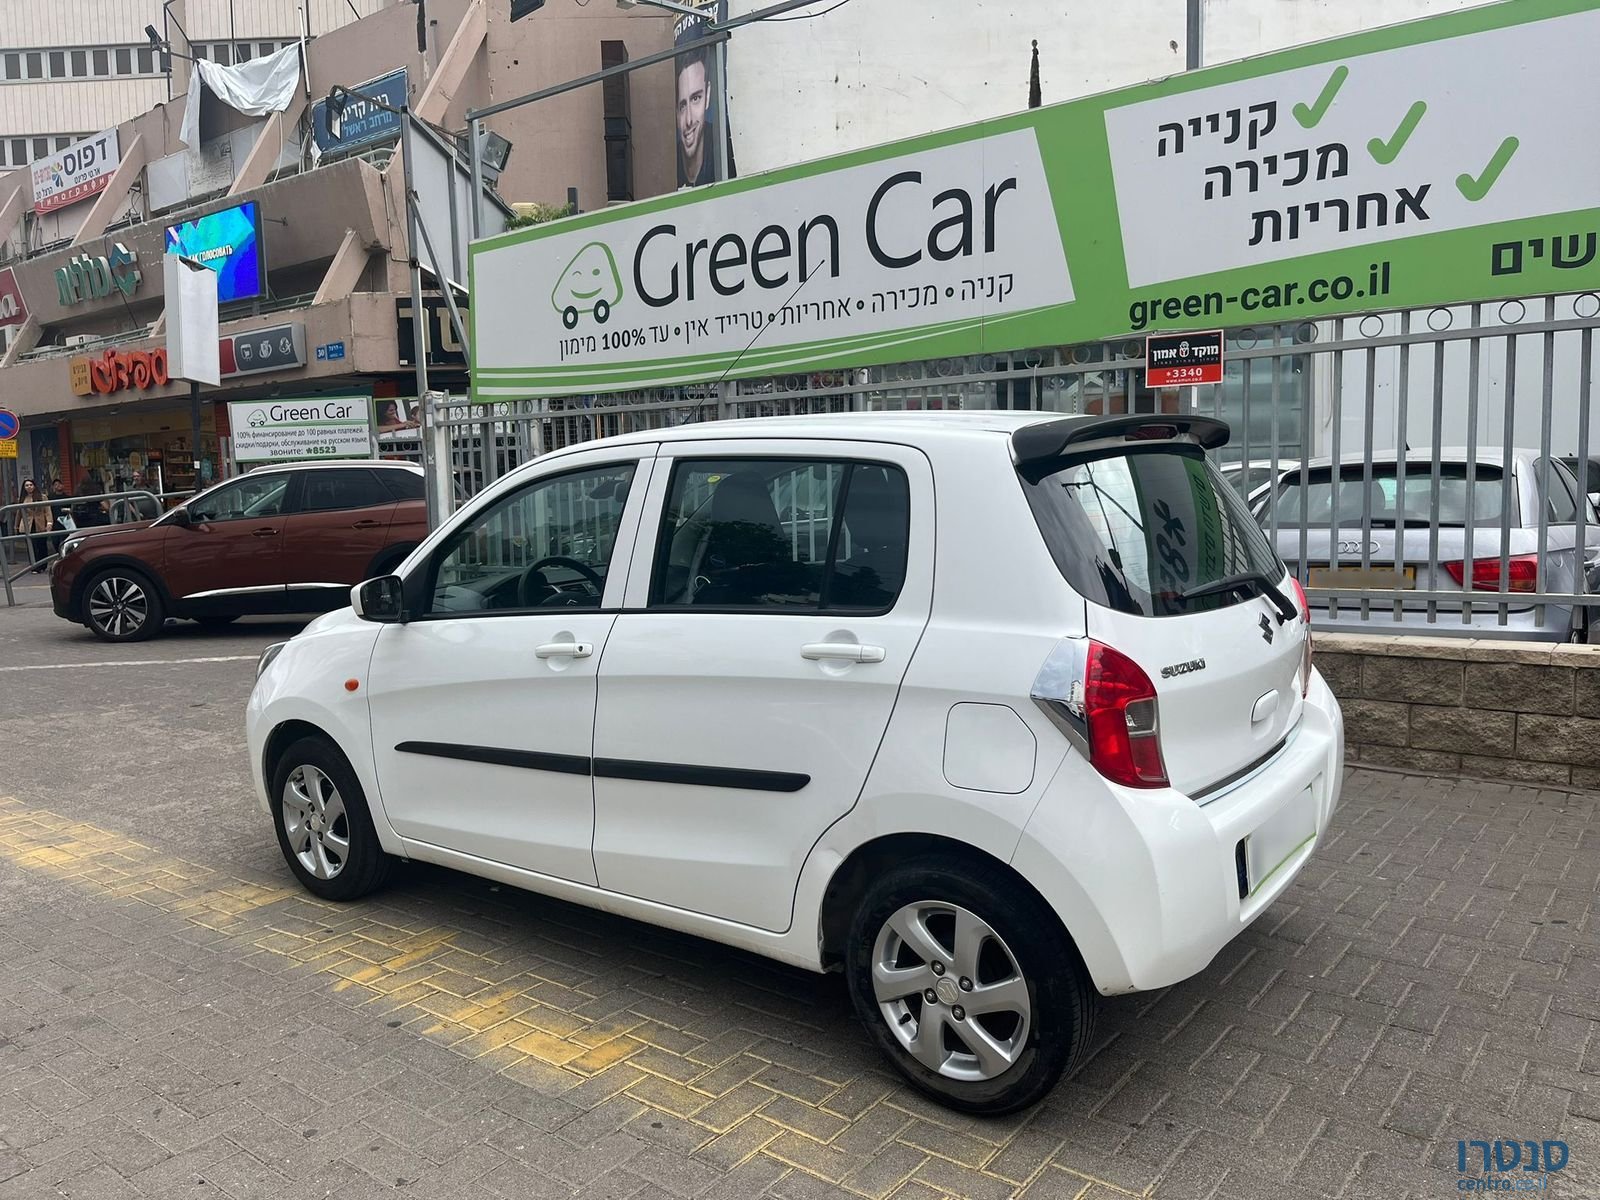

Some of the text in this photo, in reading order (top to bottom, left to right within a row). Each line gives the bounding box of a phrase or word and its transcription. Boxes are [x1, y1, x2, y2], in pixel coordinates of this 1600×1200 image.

[369, 111, 392, 128] מרחב
[1157, 100, 1277, 157] קנייה
[63, 138, 107, 176] דפוס
[1204, 142, 1349, 200] מכירה
[1249, 184, 1431, 246] אחריות
[633, 171, 1017, 308] Green Car
[1129, 261, 1391, 330] green-car.co.il
[560, 273, 1014, 361] קניה מכירה אחריות טרייד אין עד 100% מימון
[1153, 348, 1177, 362] אמון
[1191, 345, 1219, 358] מוקד
[270, 402, 352, 421] Green Car
[270, 448, 304, 456] звоните:
[1160, 657, 1206, 679] SUZUKI
